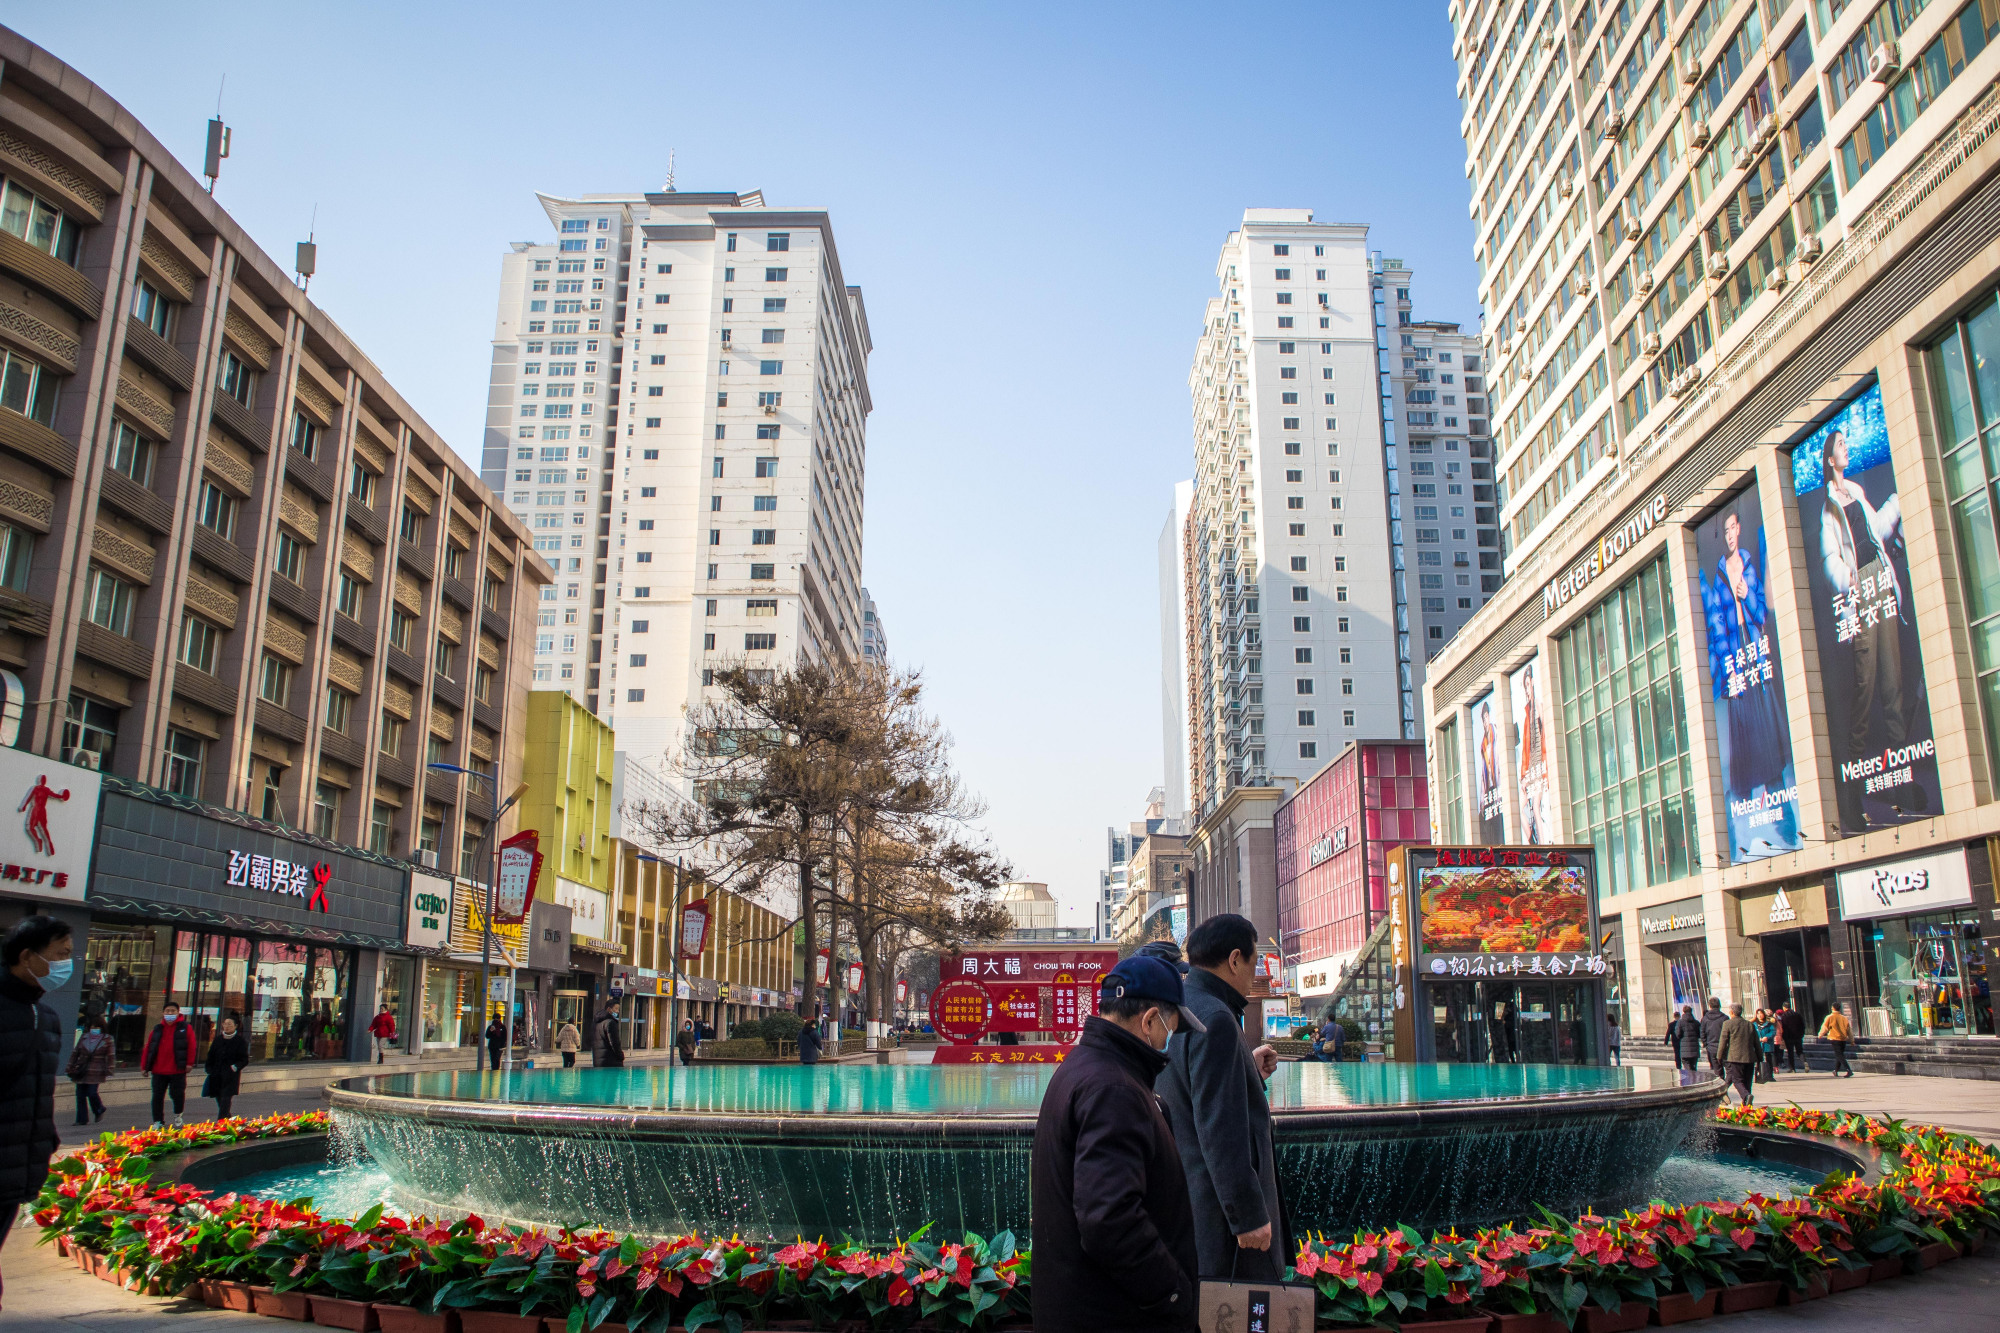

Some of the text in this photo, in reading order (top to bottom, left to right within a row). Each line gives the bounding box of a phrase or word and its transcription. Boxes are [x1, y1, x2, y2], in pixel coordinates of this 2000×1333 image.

[1832, 566, 1893, 617] 云朵羽绒
[1724, 634, 1770, 674] 云朵羽绒
[1865, 766, 1913, 794] 美特斯邦威
[1748, 806, 1783, 829] 美特斯邦威
[227, 849, 309, 897] 劲霸男装
[1769, 908, 1797, 923] adidas
[962, 958, 1021, 975] 周大福
[1057, 989, 1074, 997] 富强
[946, 996, 982, 1004] 人民有信仰
[1057, 998, 1074, 1006] 民主
[945, 1005, 982, 1014] 国家有力量
[1057, 1007, 1074, 1015] 文明
[945, 1015, 982, 1023] 民族有希望
[1016, 1011, 1036, 1019] 价值观
[1057, 1016, 1074, 1024] 和谐
[970, 1052, 1045, 1063] 不忘初心
